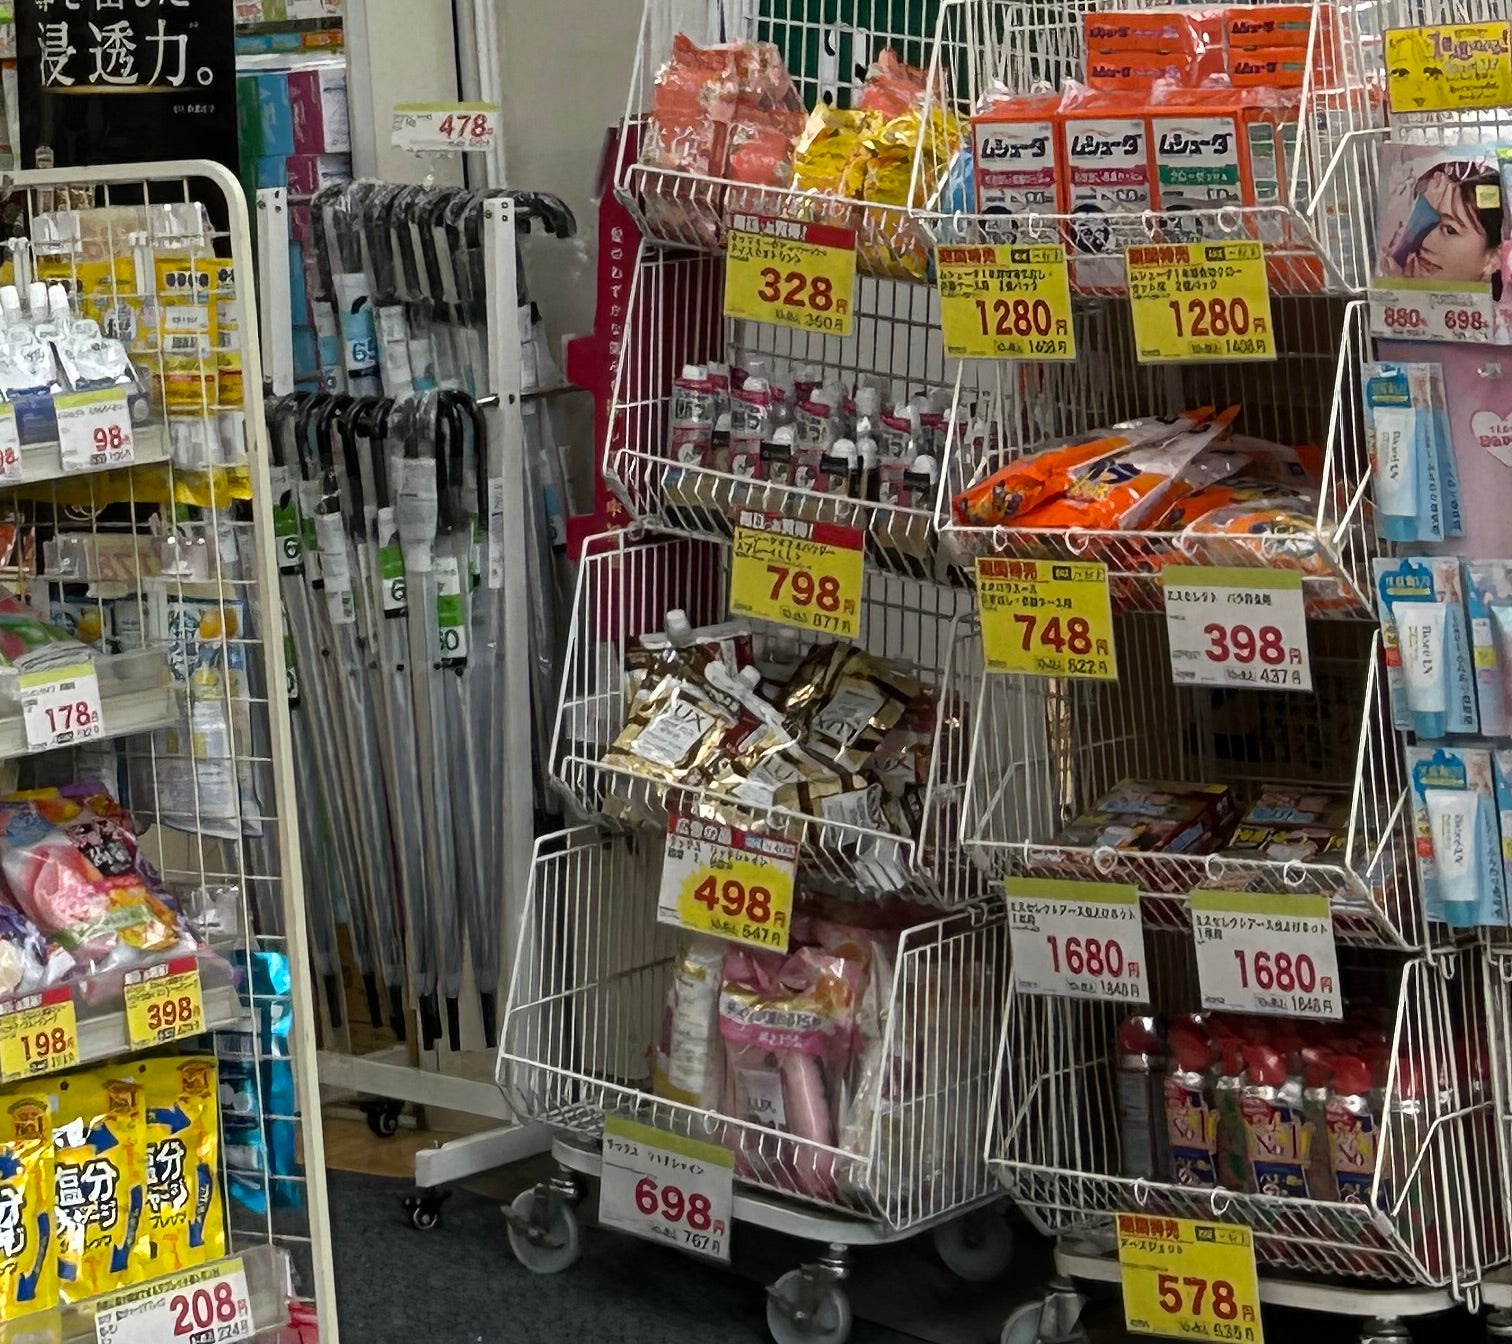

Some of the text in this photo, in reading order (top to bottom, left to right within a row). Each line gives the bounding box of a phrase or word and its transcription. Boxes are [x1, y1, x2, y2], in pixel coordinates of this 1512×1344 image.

[37, 18, 214, 88] 浸透力。
[757, 266, 848, 315] 328円
[975, 298, 1068, 337] 1280円
[1169, 296, 1267, 338] 1280円
[766, 563, 856, 616] 798円
[1013, 613, 1109, 656] 748円
[1203, 622, 1303, 666] 398円
[693, 874, 786, 929] 498円
[1046, 934, 1140, 978] 1680円
[1233, 949, 1333, 994] 1680円
[55, 1161, 117, 1209] 塩分
[635, 1176, 726, 1237] 698円
[169, 1281, 247, 1337] 208円
[1157, 1273, 1255, 1323] 578円
